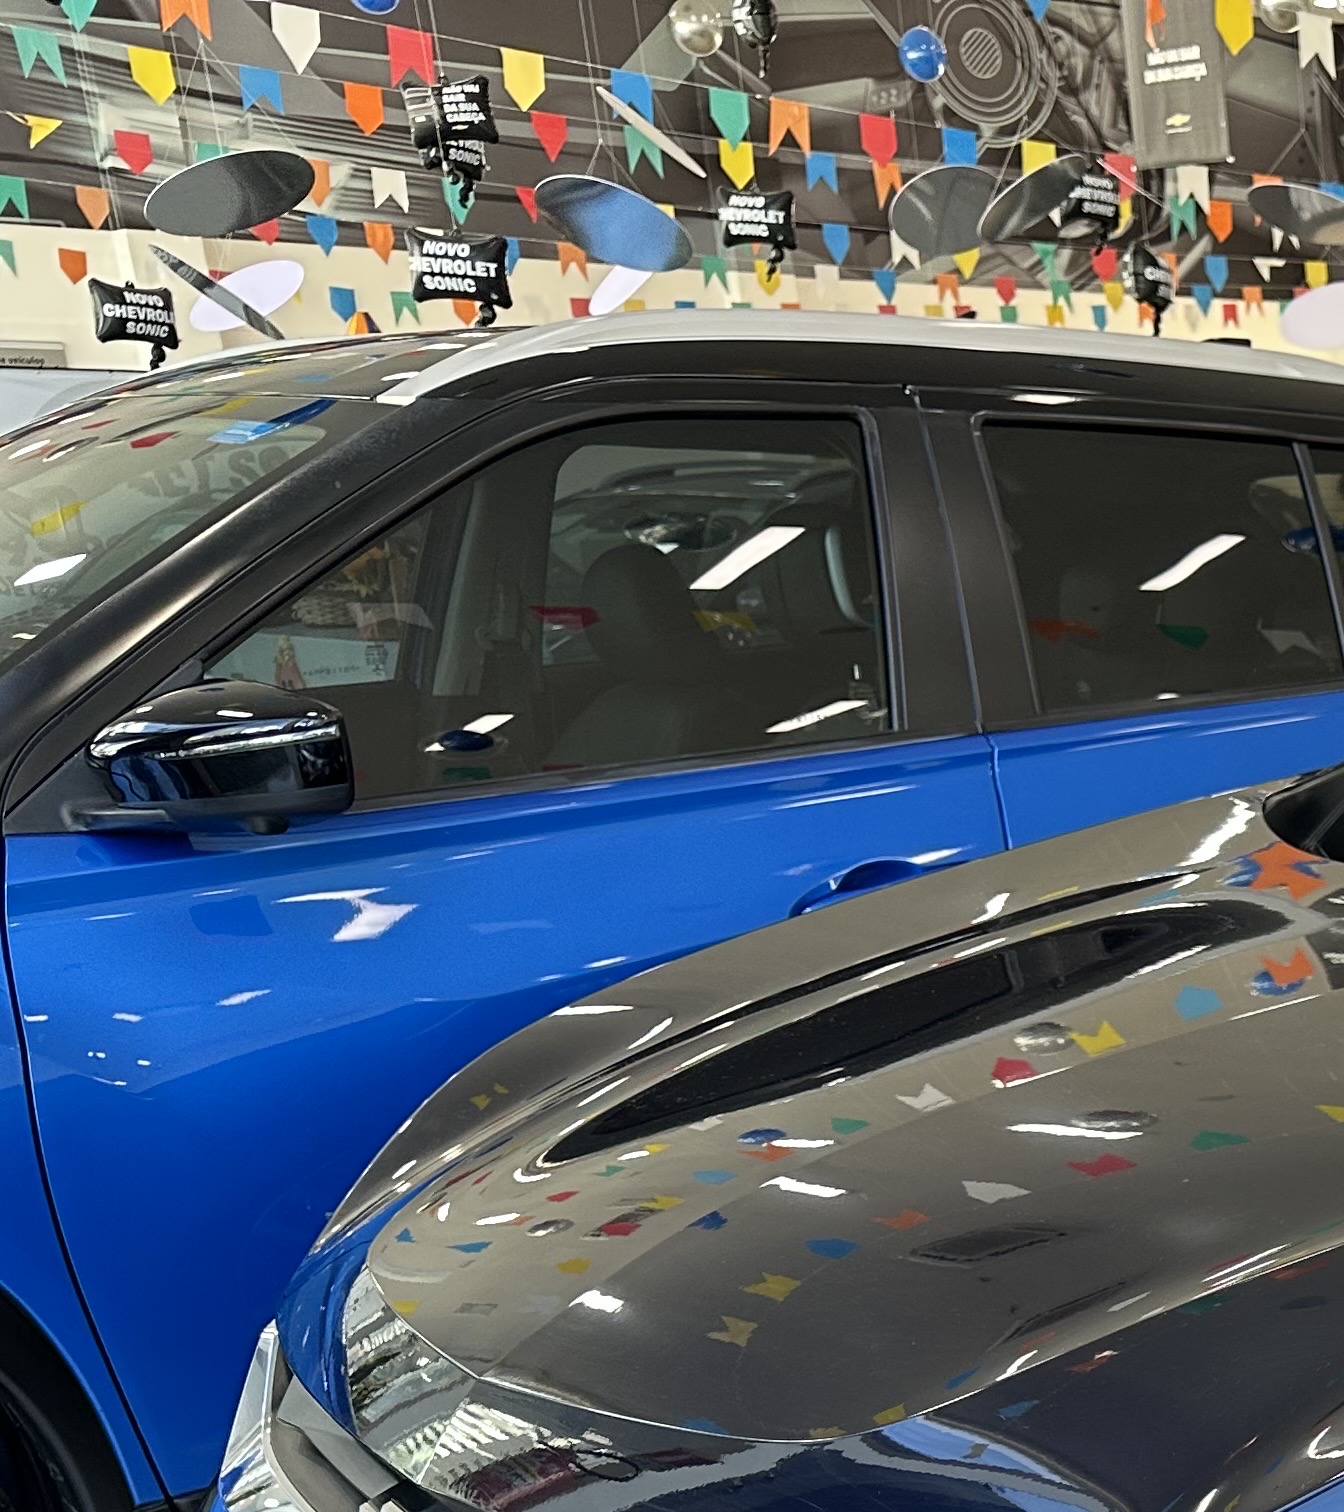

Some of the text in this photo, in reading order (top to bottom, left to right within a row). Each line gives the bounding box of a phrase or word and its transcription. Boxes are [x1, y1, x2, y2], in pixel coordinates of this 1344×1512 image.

[448, 148, 480, 166] SONIC
[728, 194, 766, 208] NOVO
[422, 240, 471, 258] NOVO
[422, 274, 477, 293] SONIC
[123, 291, 164, 307] NOVO
[126, 321, 169, 338] SONIC
